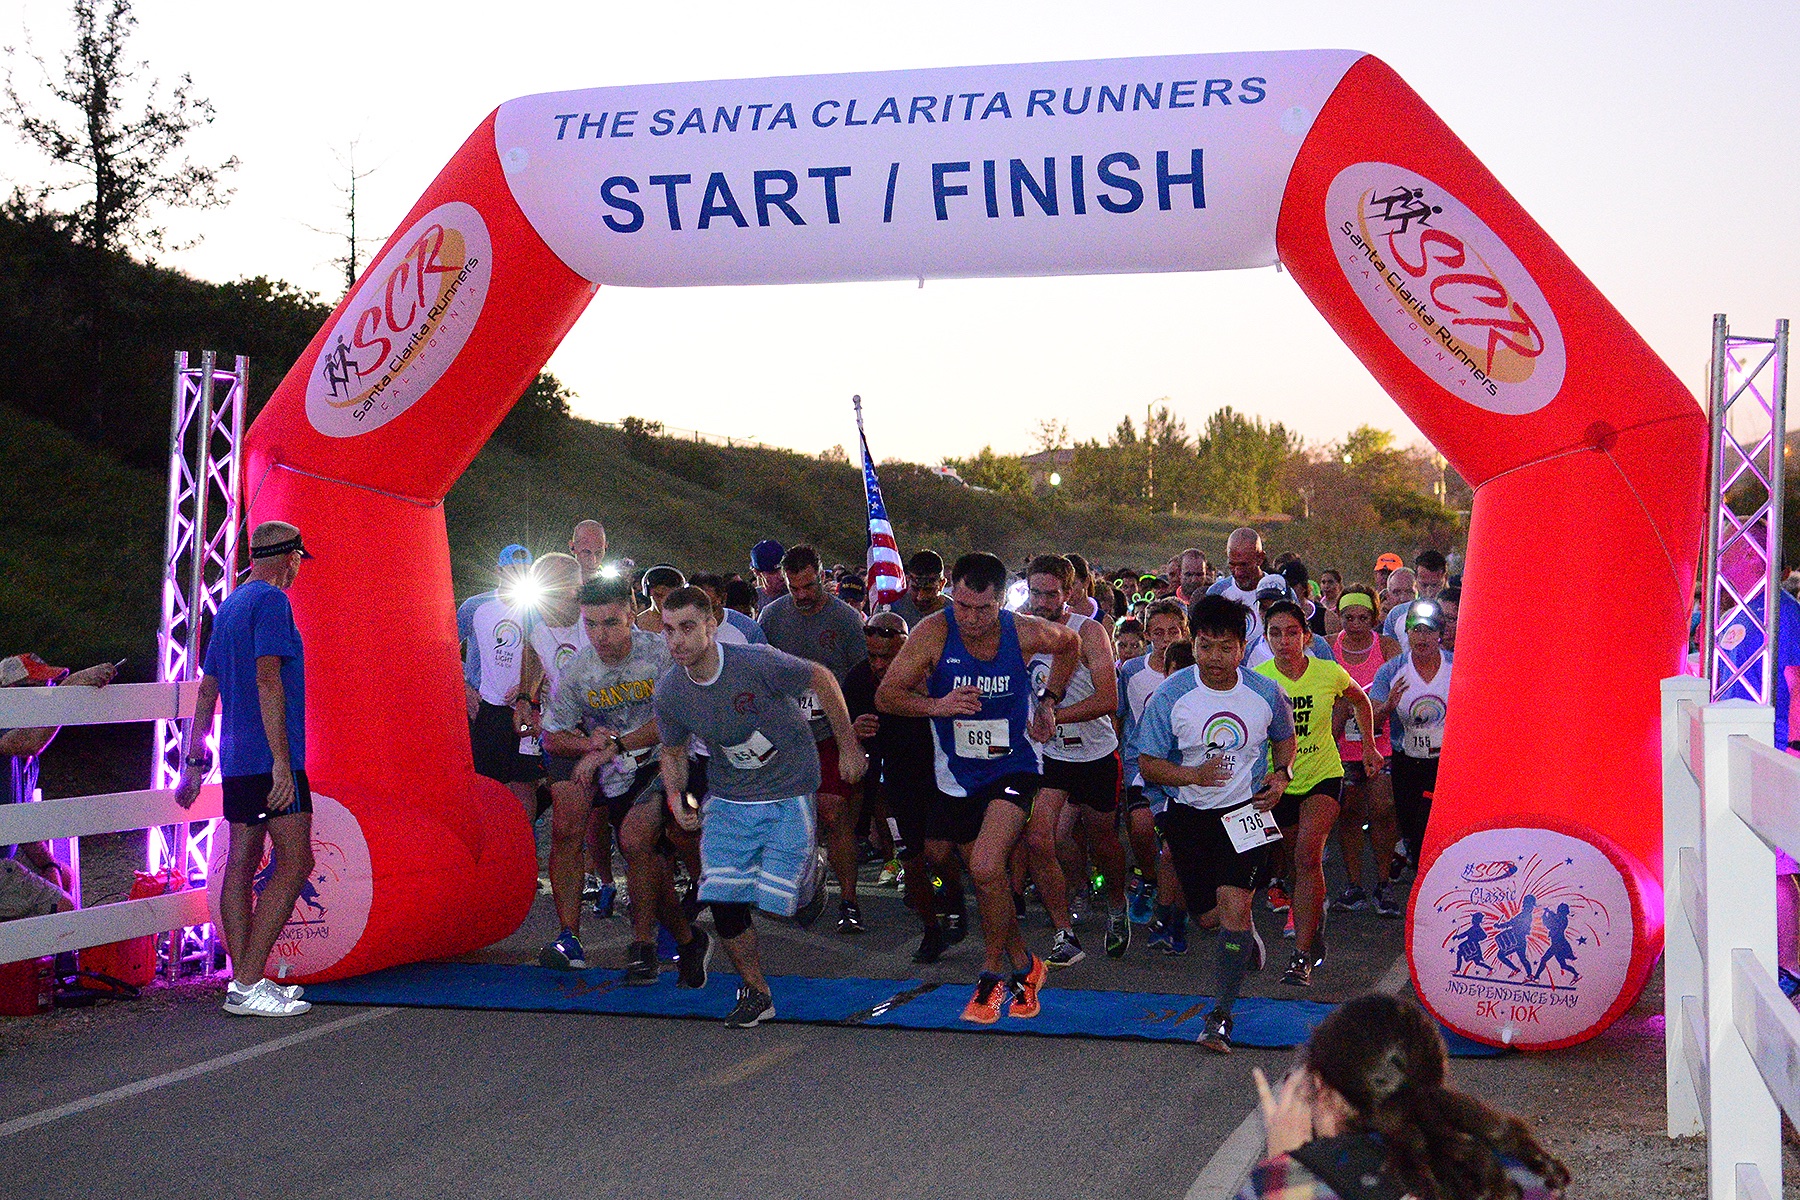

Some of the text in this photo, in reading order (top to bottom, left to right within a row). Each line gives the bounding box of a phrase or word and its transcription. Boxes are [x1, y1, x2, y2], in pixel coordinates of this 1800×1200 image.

[554, 77, 1268, 141] THE SANTA CLARITA RUNNERS
[601, 148, 1207, 234] START / FINISH
[353, 223, 463, 377] SCR
[1340, 221, 1498, 397] Santa Clarita Runners
[1389, 228, 1545, 377] SCR
[1349, 254, 1467, 387] CALIFORNIA
[353, 256, 479, 422] Santa Clarita Runners
[380, 286, 477, 411] CALIFORNIA
[587, 678, 656, 709] CANYON
[977, 675, 1011, 693] COAST
[1290, 695, 1313, 709] UDE
[968, 730, 992, 746] 689
[1238, 812, 1264, 834] 736
[1470, 887, 1517, 906] Classic
[304, 926, 330, 940] DAY
[277, 940, 304, 958] 10K
[1445, 980, 1579, 1008] INDEPENDENCE DAY
[1476, 1000, 1543, 1025] 5K 10K
